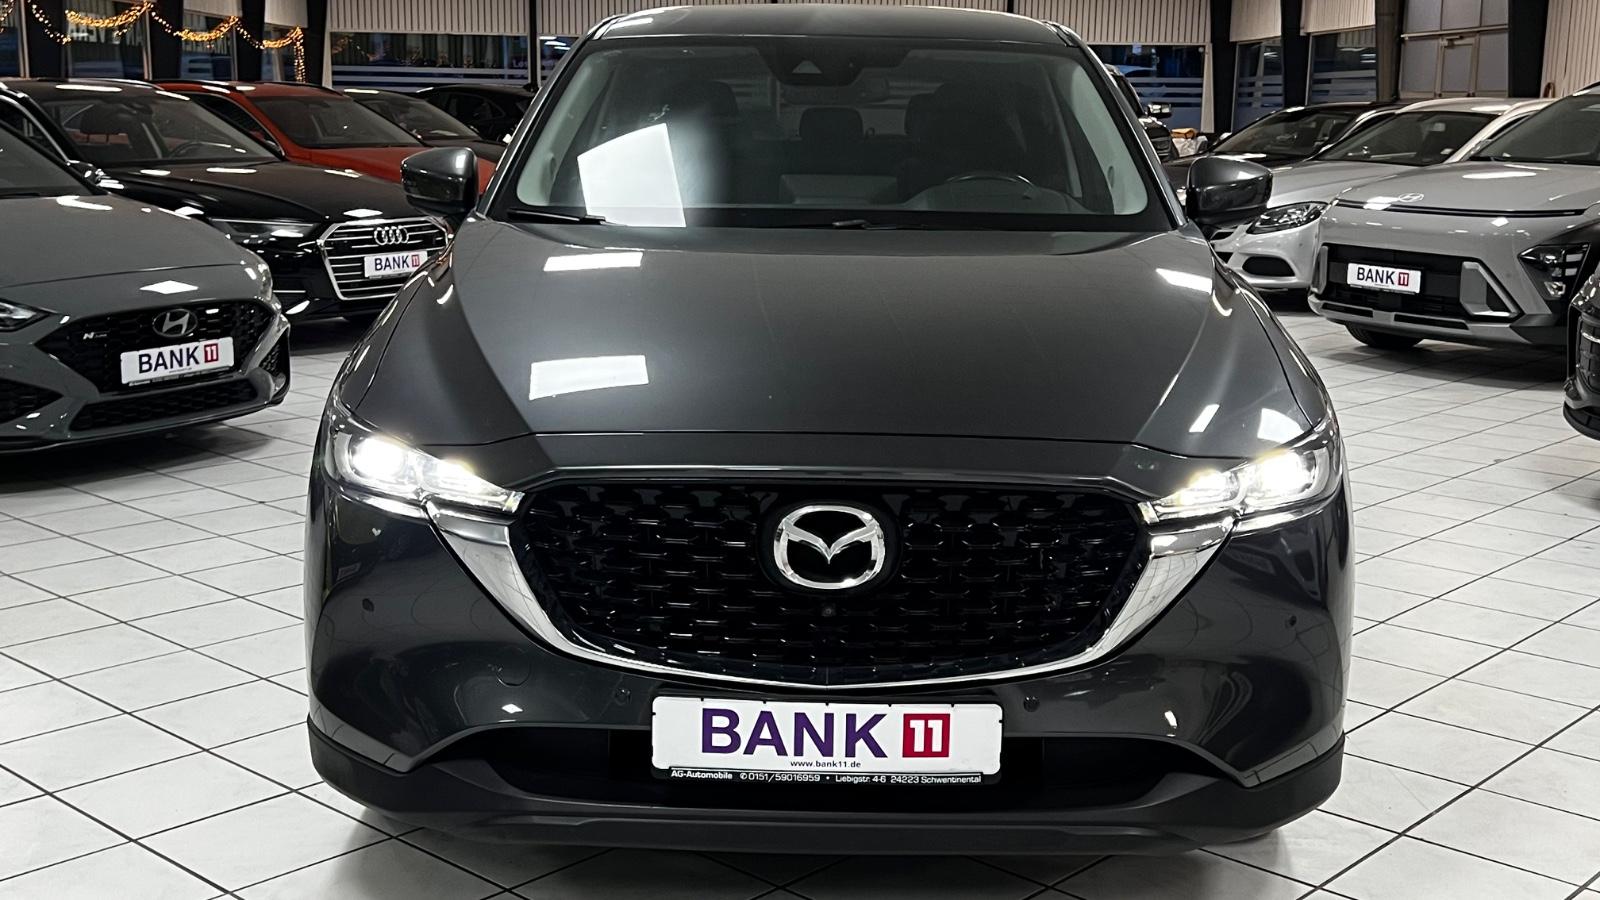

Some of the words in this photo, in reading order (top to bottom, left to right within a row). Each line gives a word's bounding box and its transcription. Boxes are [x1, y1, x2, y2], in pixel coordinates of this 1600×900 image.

[375, 256, 409, 271] BANK
[1357, 268, 1395, 285] BANK
[1399, 272, 1409, 286] 11
[138, 346, 200, 374] BANK
[205, 344, 218, 362] 11
[702, 708, 888, 757] BANK
[907, 718, 946, 754] 11
[790, 760, 861, 768] www.bank11.de
[671, 770, 733, 779] AG-Automobile
[891, 775, 919, 784] 24223
[921, 775, 981, 784] Schwentinental
